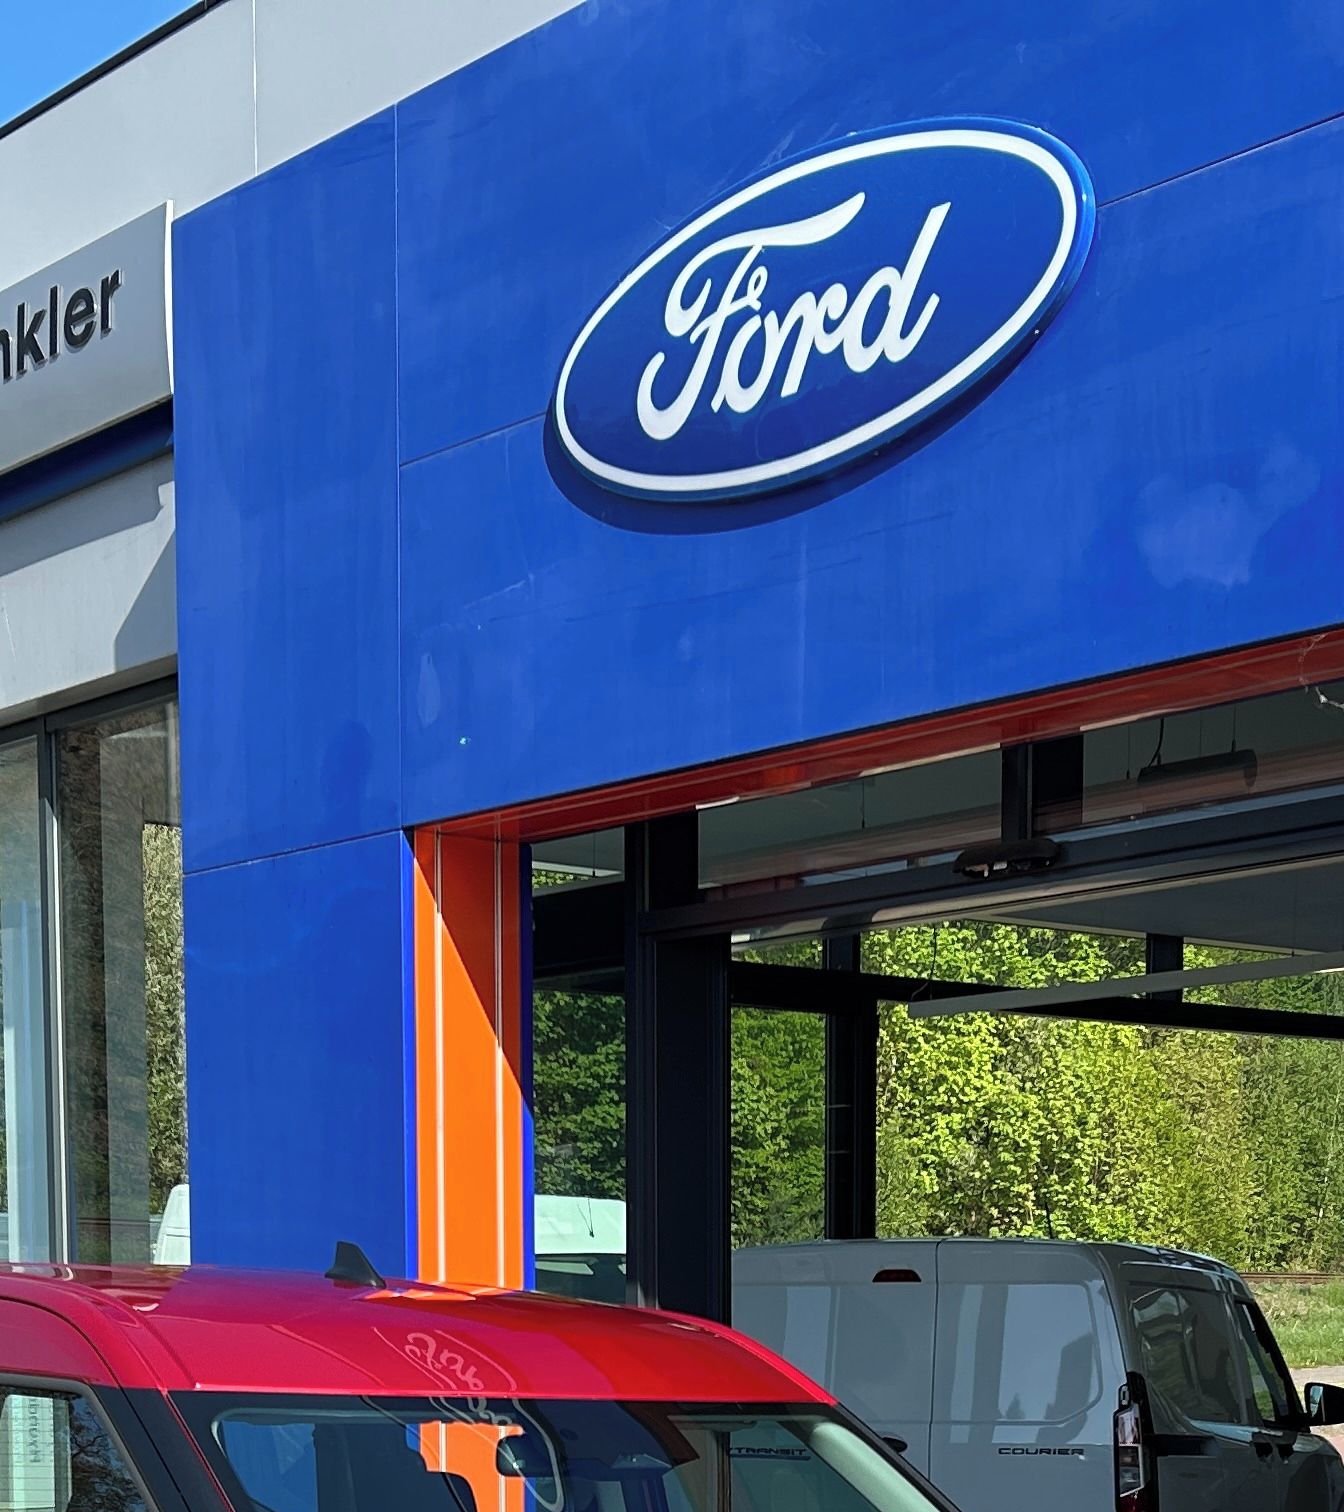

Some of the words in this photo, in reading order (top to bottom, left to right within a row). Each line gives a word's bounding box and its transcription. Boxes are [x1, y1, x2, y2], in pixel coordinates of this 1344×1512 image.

[636, 191, 952, 441] Ford
[735, 1446, 807, 1456] TRANSIT
[998, 1447, 1085, 1456] COURIER
